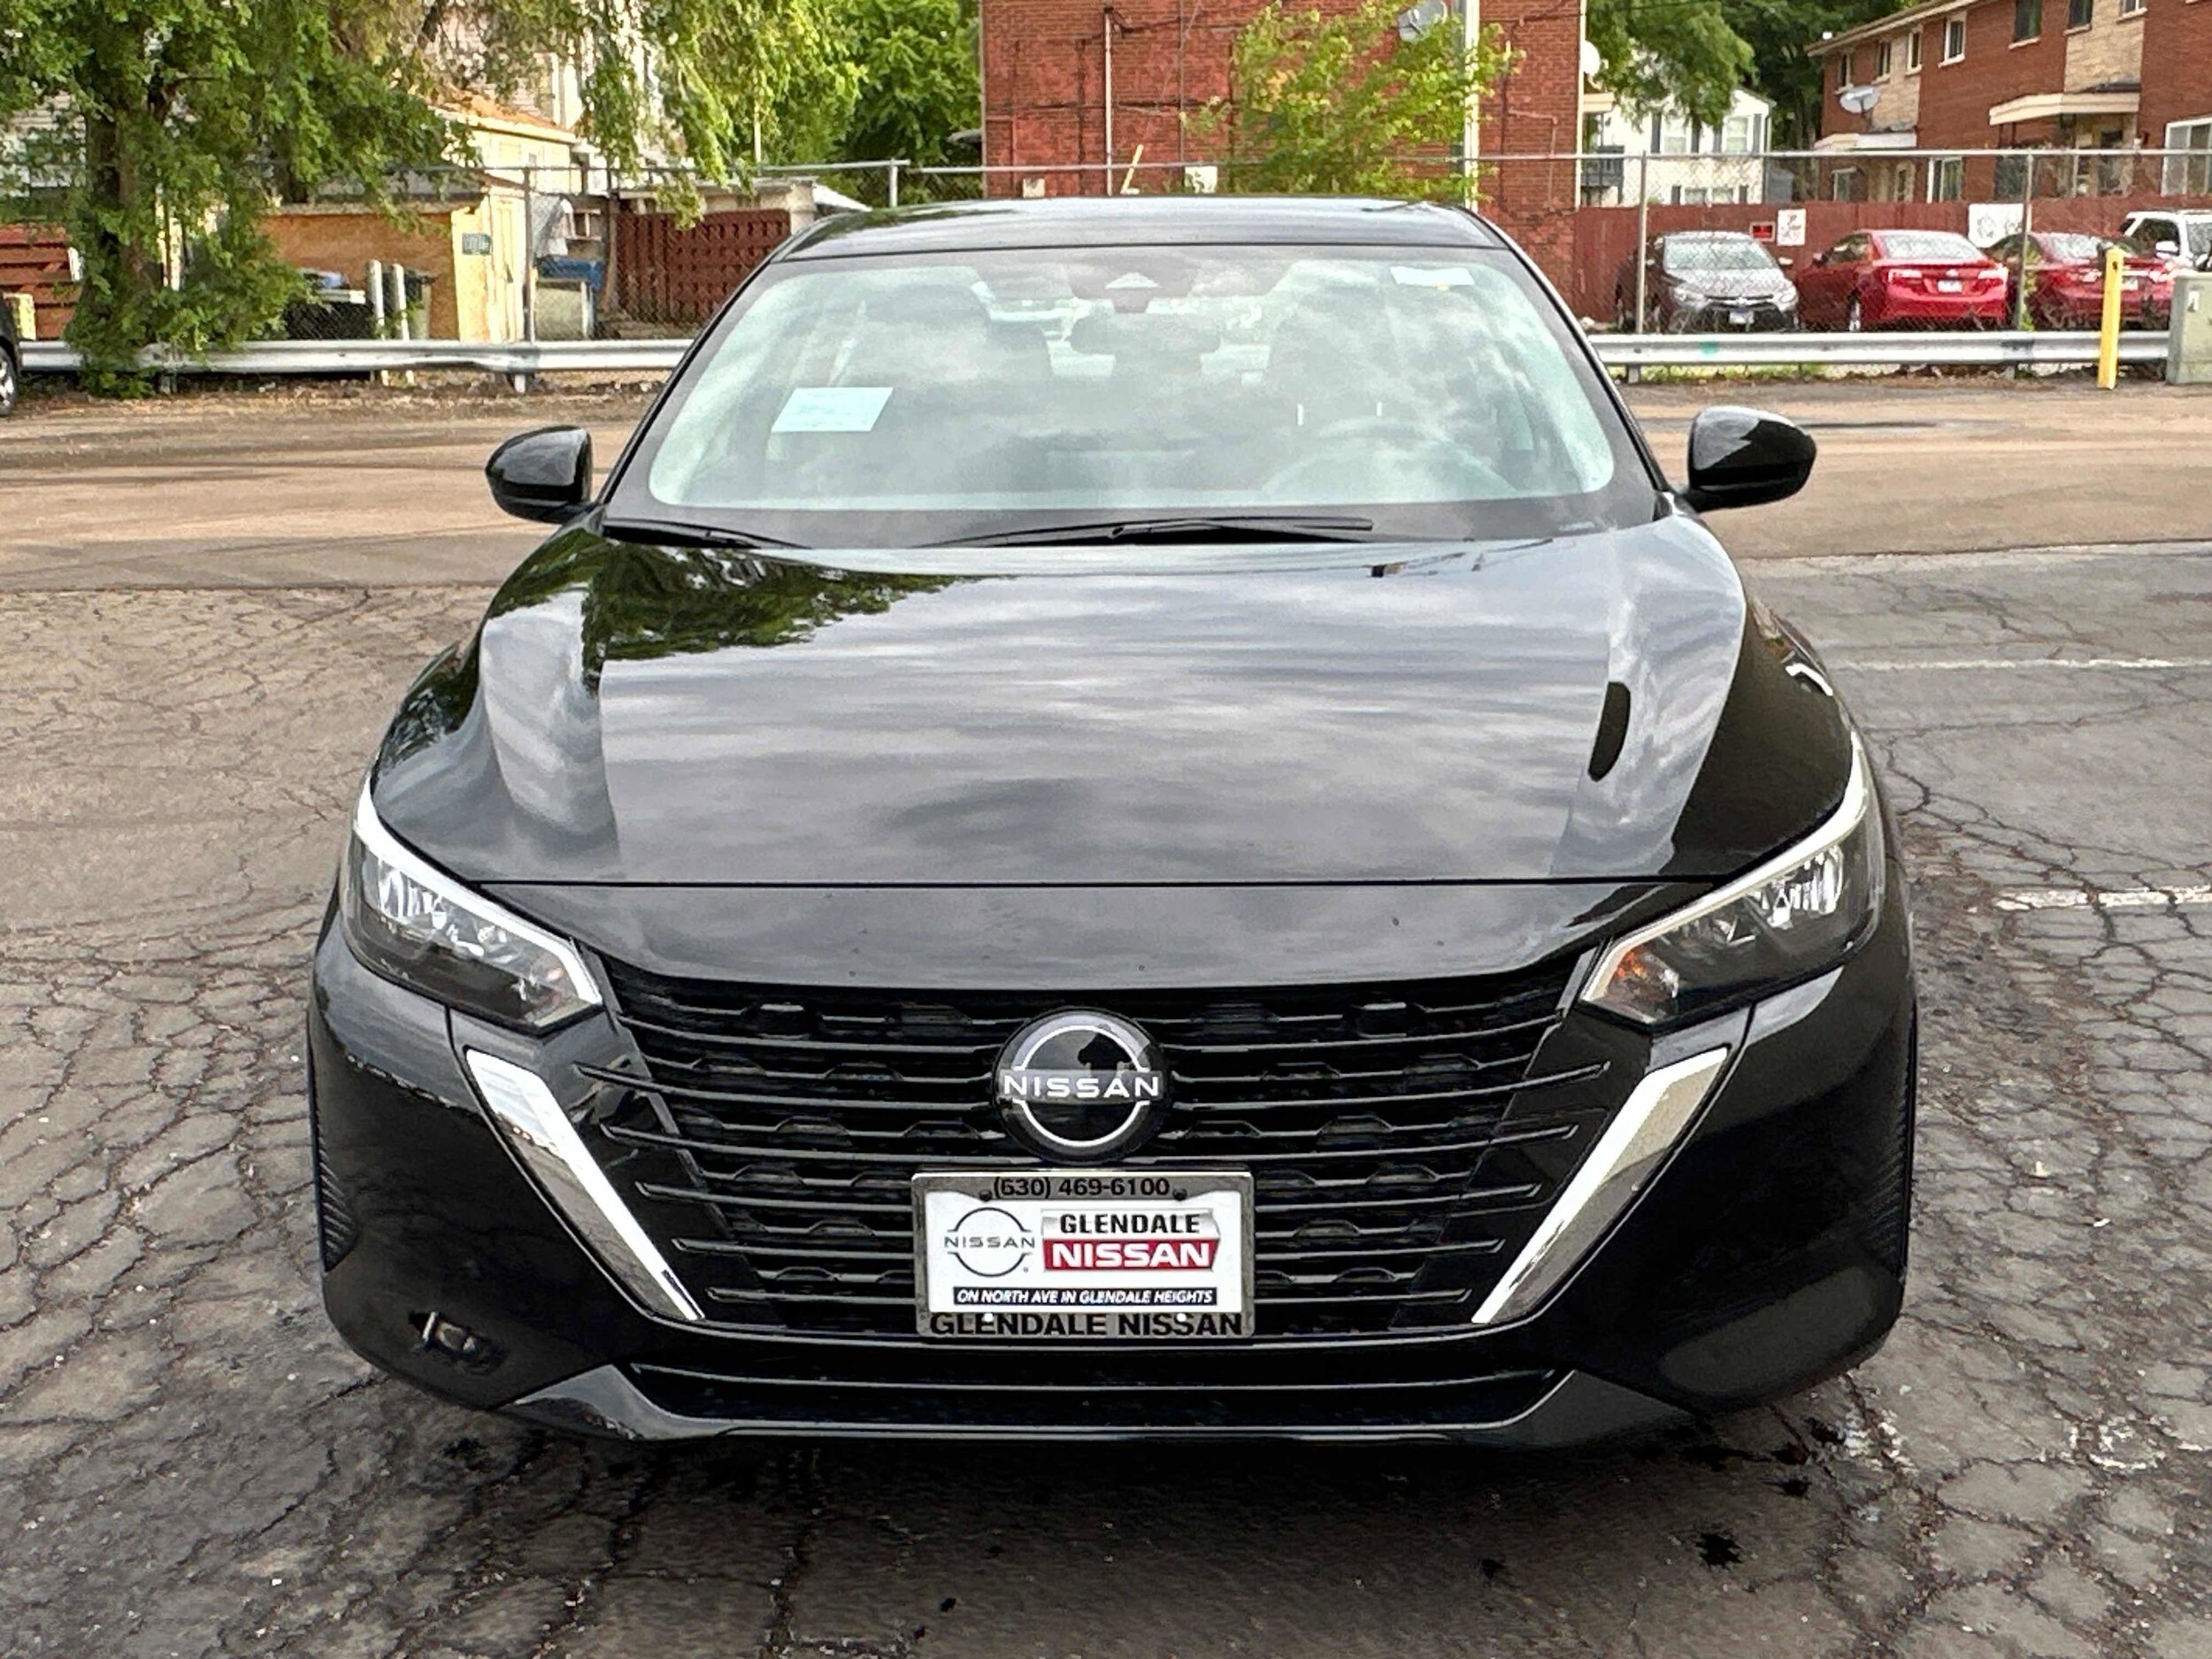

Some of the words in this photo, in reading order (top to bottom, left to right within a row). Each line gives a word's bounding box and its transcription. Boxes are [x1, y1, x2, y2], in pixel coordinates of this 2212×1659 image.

[1003, 1075, 1160, 1098] NISSAN
[994, 1177, 1051, 1199] (630)
[1058, 1178, 1171, 1196] 469-6100
[1060, 1214, 1201, 1233] GLENDALE
[944, 1236, 1035, 1248] NISSAN
[1052, 1242, 1210, 1268] NISSAN
[956, 1289, 979, 1303] ON
[980, 1289, 1029, 1303] NORTH
[1031, 1290, 1058, 1304] AVE
[1060, 1290, 1077, 1304] IN
[1079, 1290, 1151, 1304] GLENDALE
[1153, 1289, 1213, 1304] HEIGHTS
[930, 1312, 1108, 1336] GLENDALE
[1118, 1312, 1242, 1336] NISSAN
